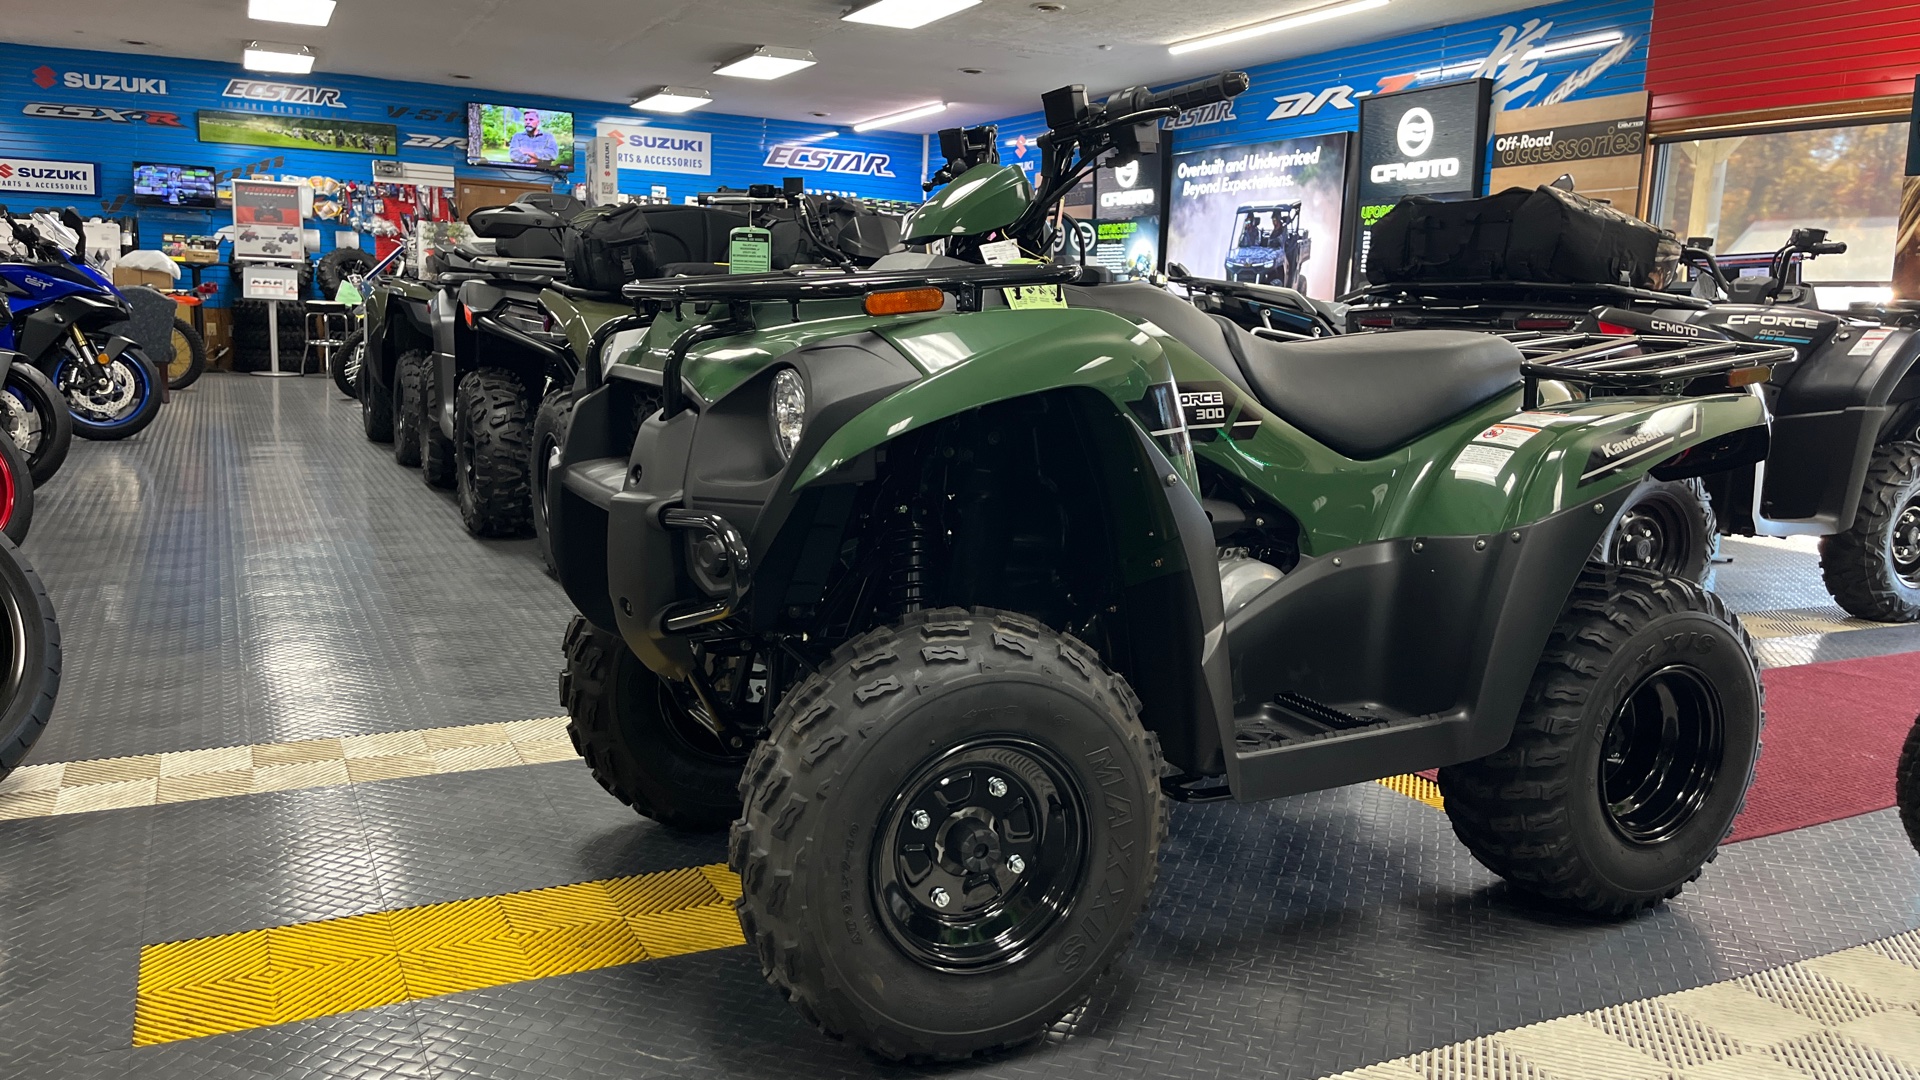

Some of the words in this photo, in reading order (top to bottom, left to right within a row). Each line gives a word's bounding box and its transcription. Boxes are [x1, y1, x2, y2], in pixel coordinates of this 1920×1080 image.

[63, 72, 167, 95] SUZUKI
[222, 78, 348, 109] ECSTAR
[22, 102, 185, 128] GSX-R
[629, 134, 703, 153] SUZUKI
[1495, 131, 1554, 152] Off-Road
[1502, 127, 1642, 166] accessories
[636, 155, 642, 164] &
[644, 155, 703, 169] ACCESSORIES
[763, 144, 896, 178] ECSTAR
[1177, 159, 1225, 180] Overbuilt
[1225, 154, 1248, 174] and
[1249, 146, 1321, 173] Underpriced
[1370, 157, 1460, 184] CFMOTO
[0, 180, 22, 188] ARTS
[35, 182, 88, 191] ACCESSORIES
[18, 166, 88, 182] SUZUKI
[1182, 177, 1220, 199] Beyond
[1221, 173, 1295, 196] Expectations.
[1651, 320, 1699, 337] CFMOTO
[1727, 314, 1819, 329] CFORCE
[1179, 392, 1224, 406] ORCE
[1196, 408, 1225, 420] 300
[1601, 427, 1665, 459] Kawasaki
[1056, 746, 1134, 973] MAXXIS
